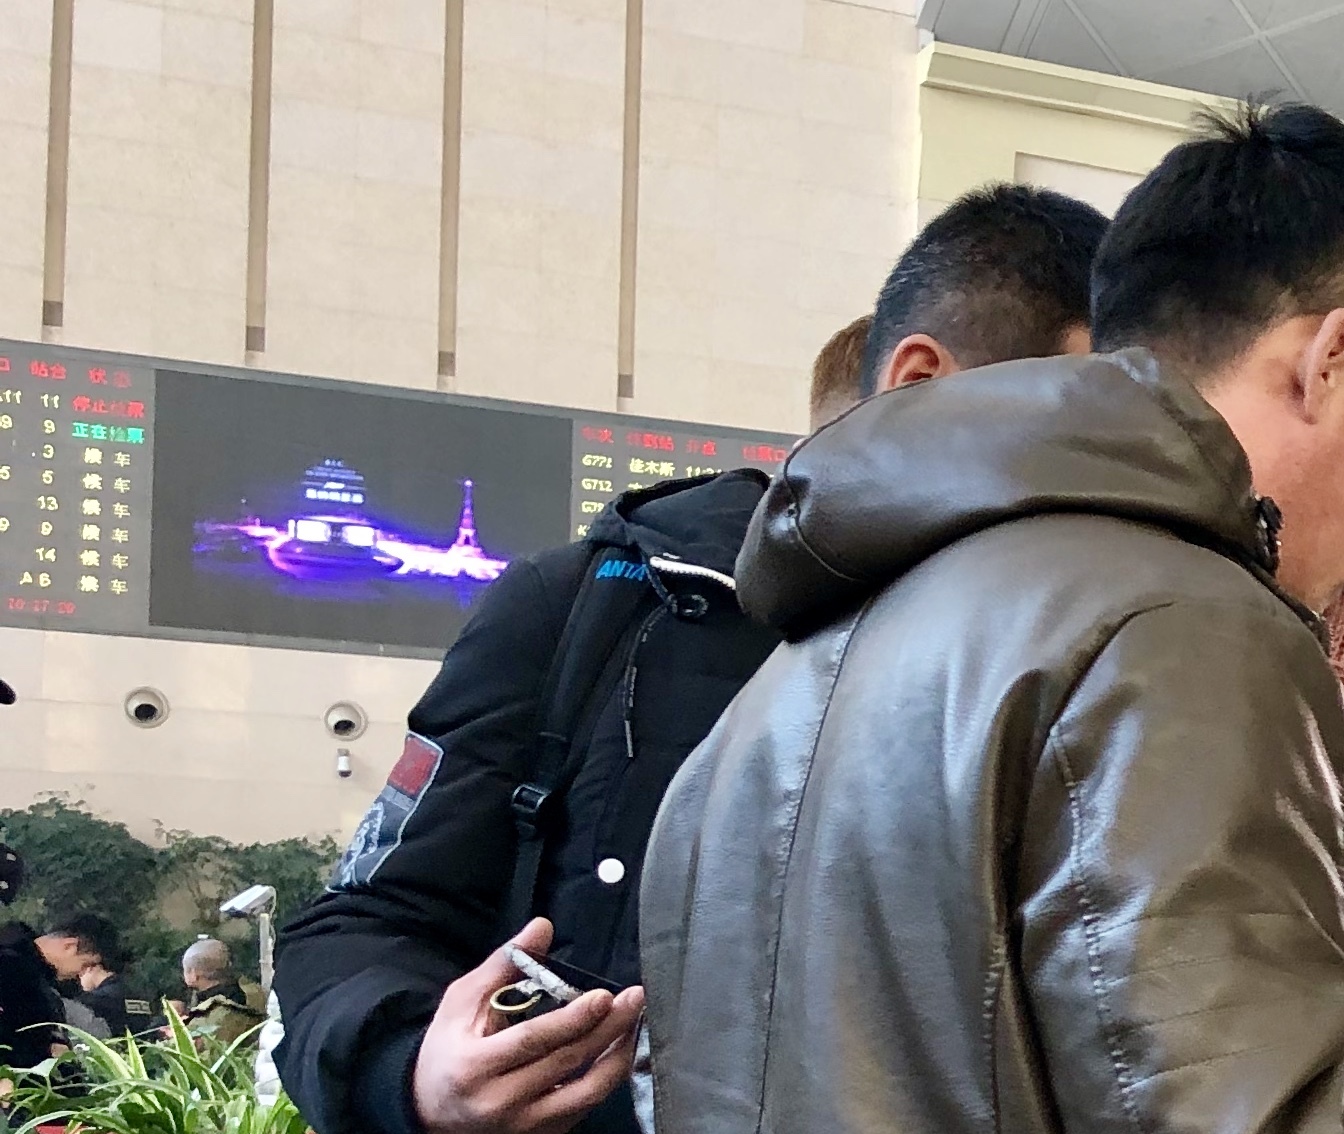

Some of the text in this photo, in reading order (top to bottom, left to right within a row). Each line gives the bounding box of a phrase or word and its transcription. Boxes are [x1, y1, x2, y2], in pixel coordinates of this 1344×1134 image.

[43, 419, 56, 434] 9
[72, 421, 145, 444] 正在检票
[42, 444, 55, 459] 3
[38, 495, 59, 511] 13
[35, 547, 57, 562] 14
[595, 559, 646, 582] ANTA
